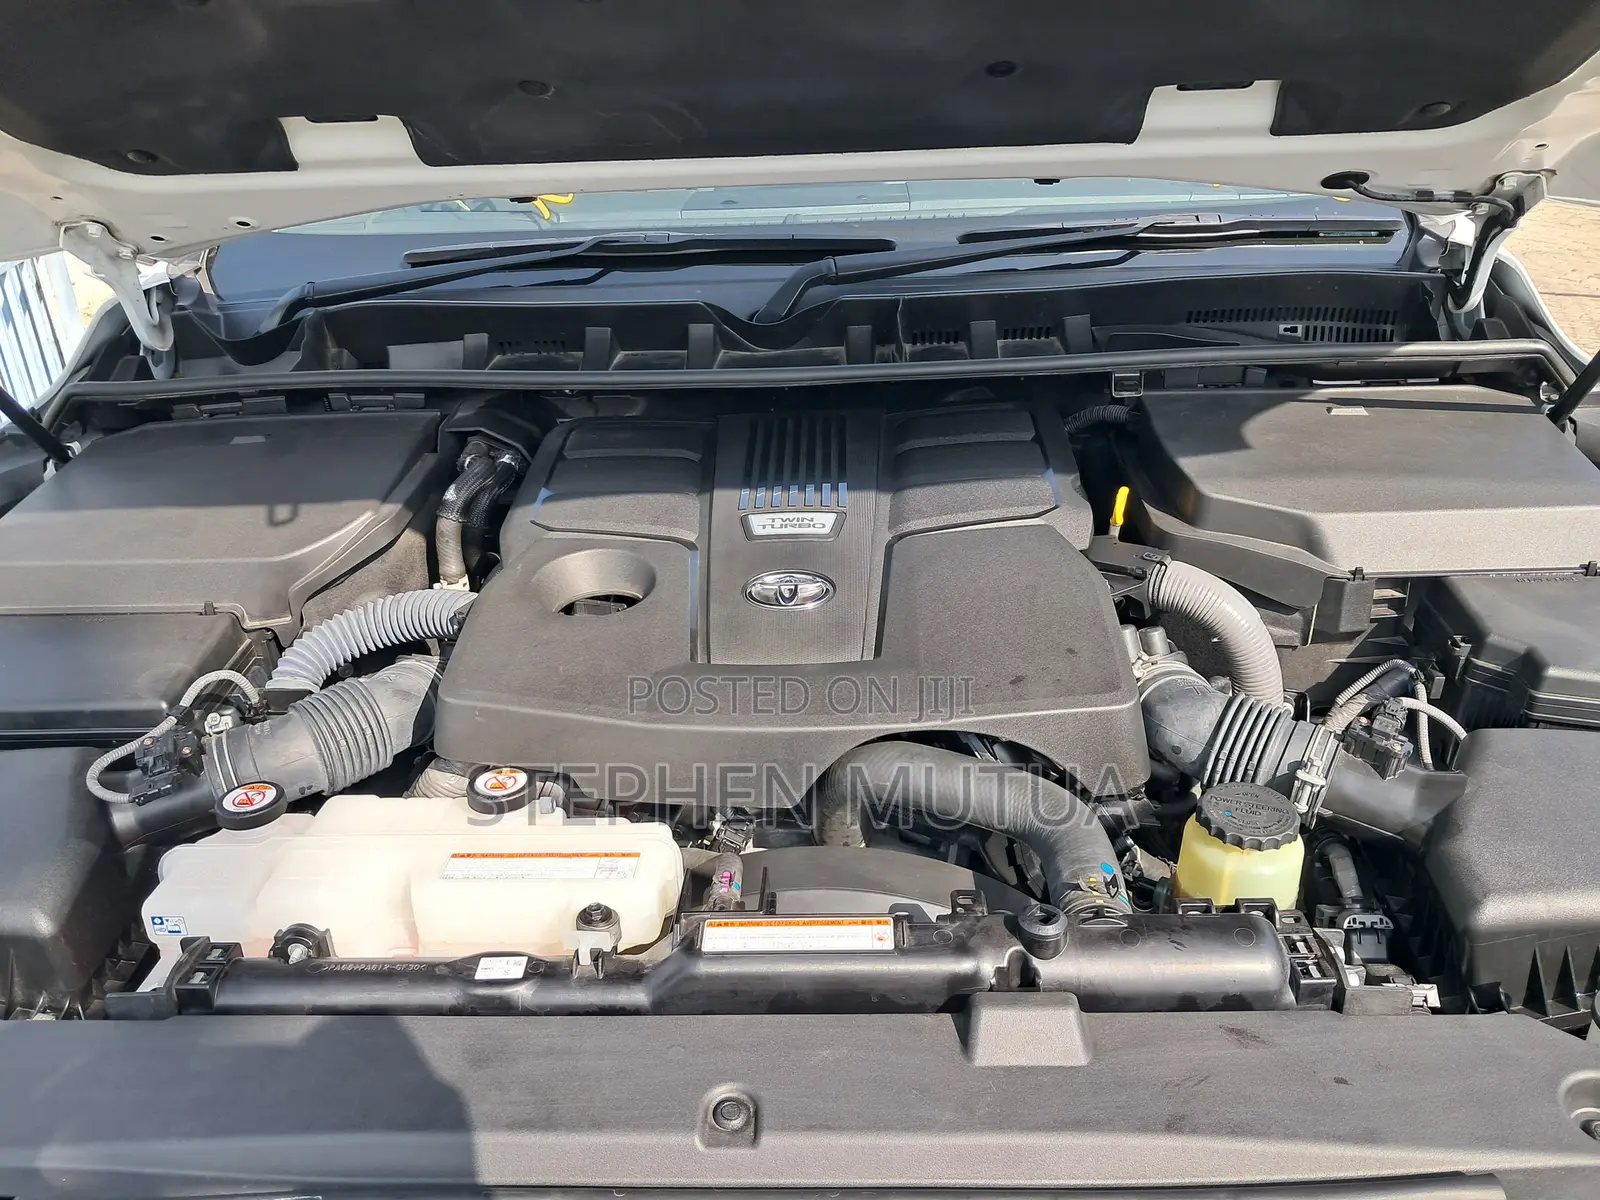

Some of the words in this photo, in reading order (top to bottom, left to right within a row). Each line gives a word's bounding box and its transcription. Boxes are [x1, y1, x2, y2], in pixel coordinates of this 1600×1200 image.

[1210, 795, 1242, 806] POWER
[1243, 801, 1290, 815] STEERING
[1235, 807, 1262, 817] FLUID
